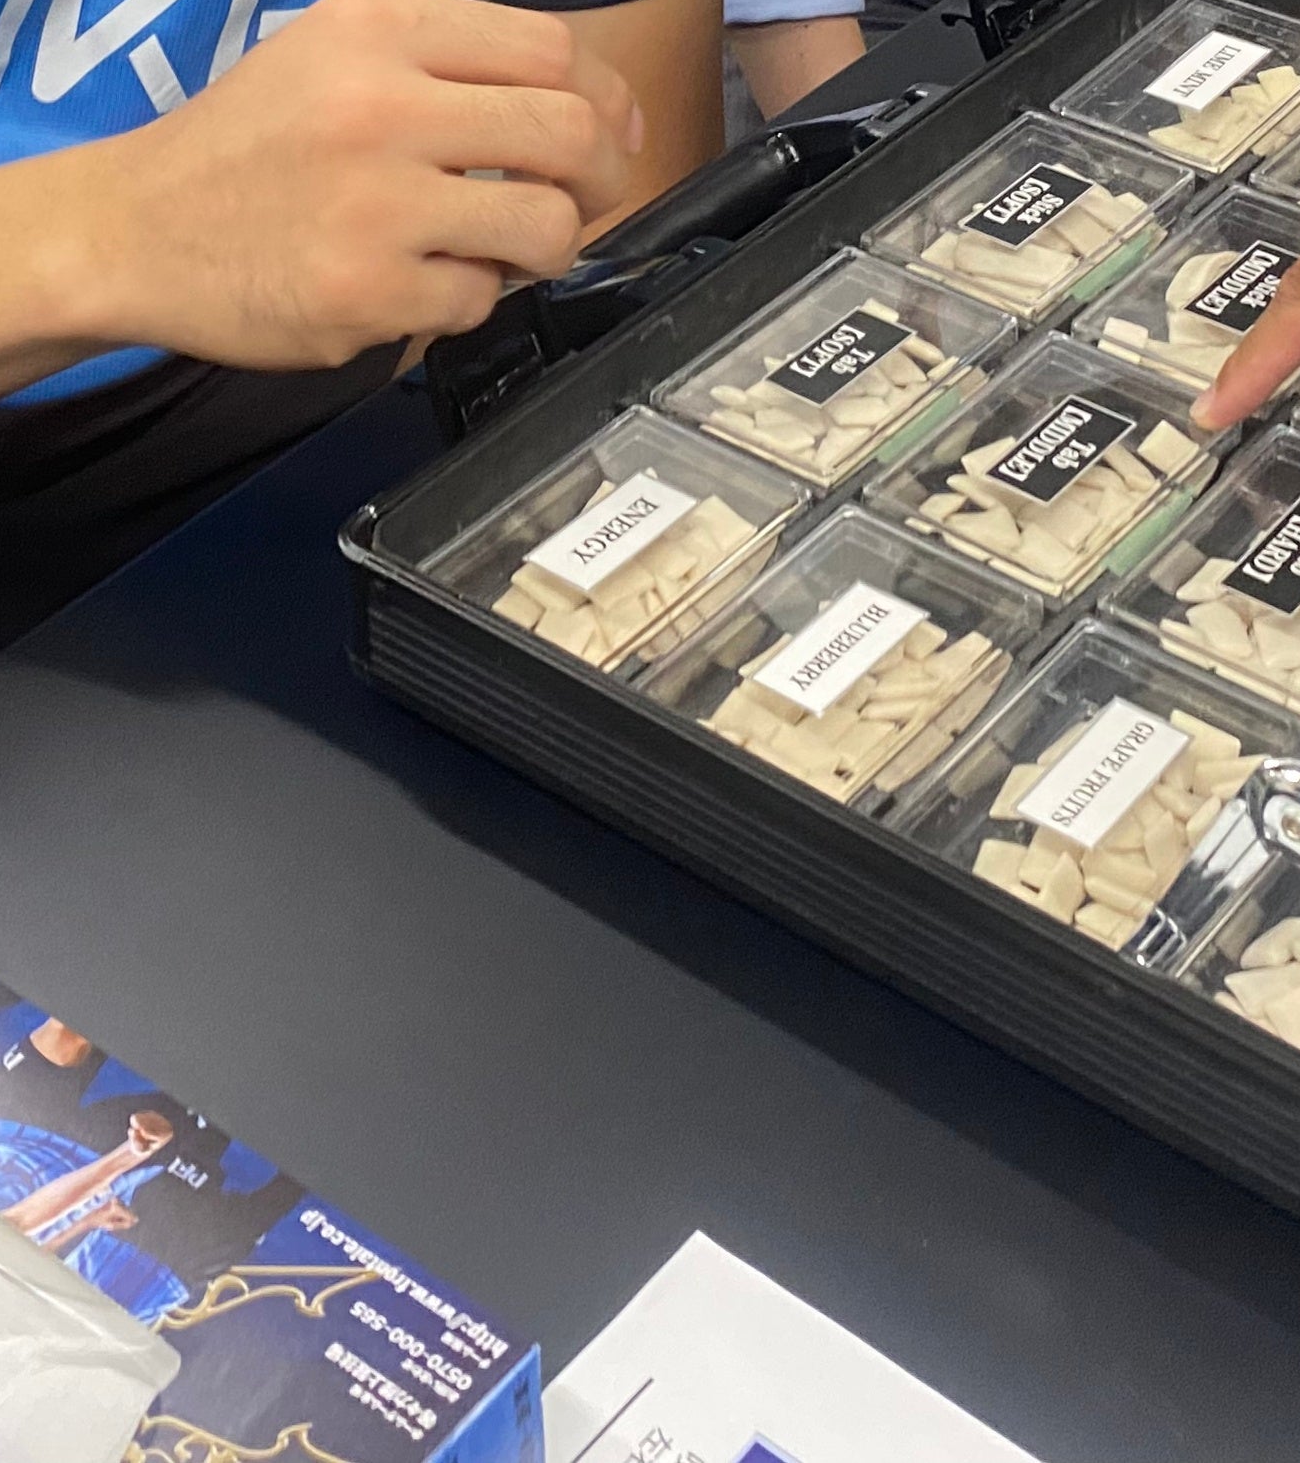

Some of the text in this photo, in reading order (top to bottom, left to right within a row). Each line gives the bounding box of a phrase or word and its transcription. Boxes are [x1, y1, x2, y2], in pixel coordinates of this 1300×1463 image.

[1172, 44, 1242, 99] LIME MINT
[1016, 193, 1064, 226] Stick
[830, 347, 876, 376] Tab
[1051, 439, 1097, 471] Tab
[570, 496, 660, 566] ENERGY
[789, 603, 890, 692] BLUEBERRY
[1051, 721, 1155, 827] GRAPE FRUITS
[349, 1300, 473, 1390] 0570-000-565
